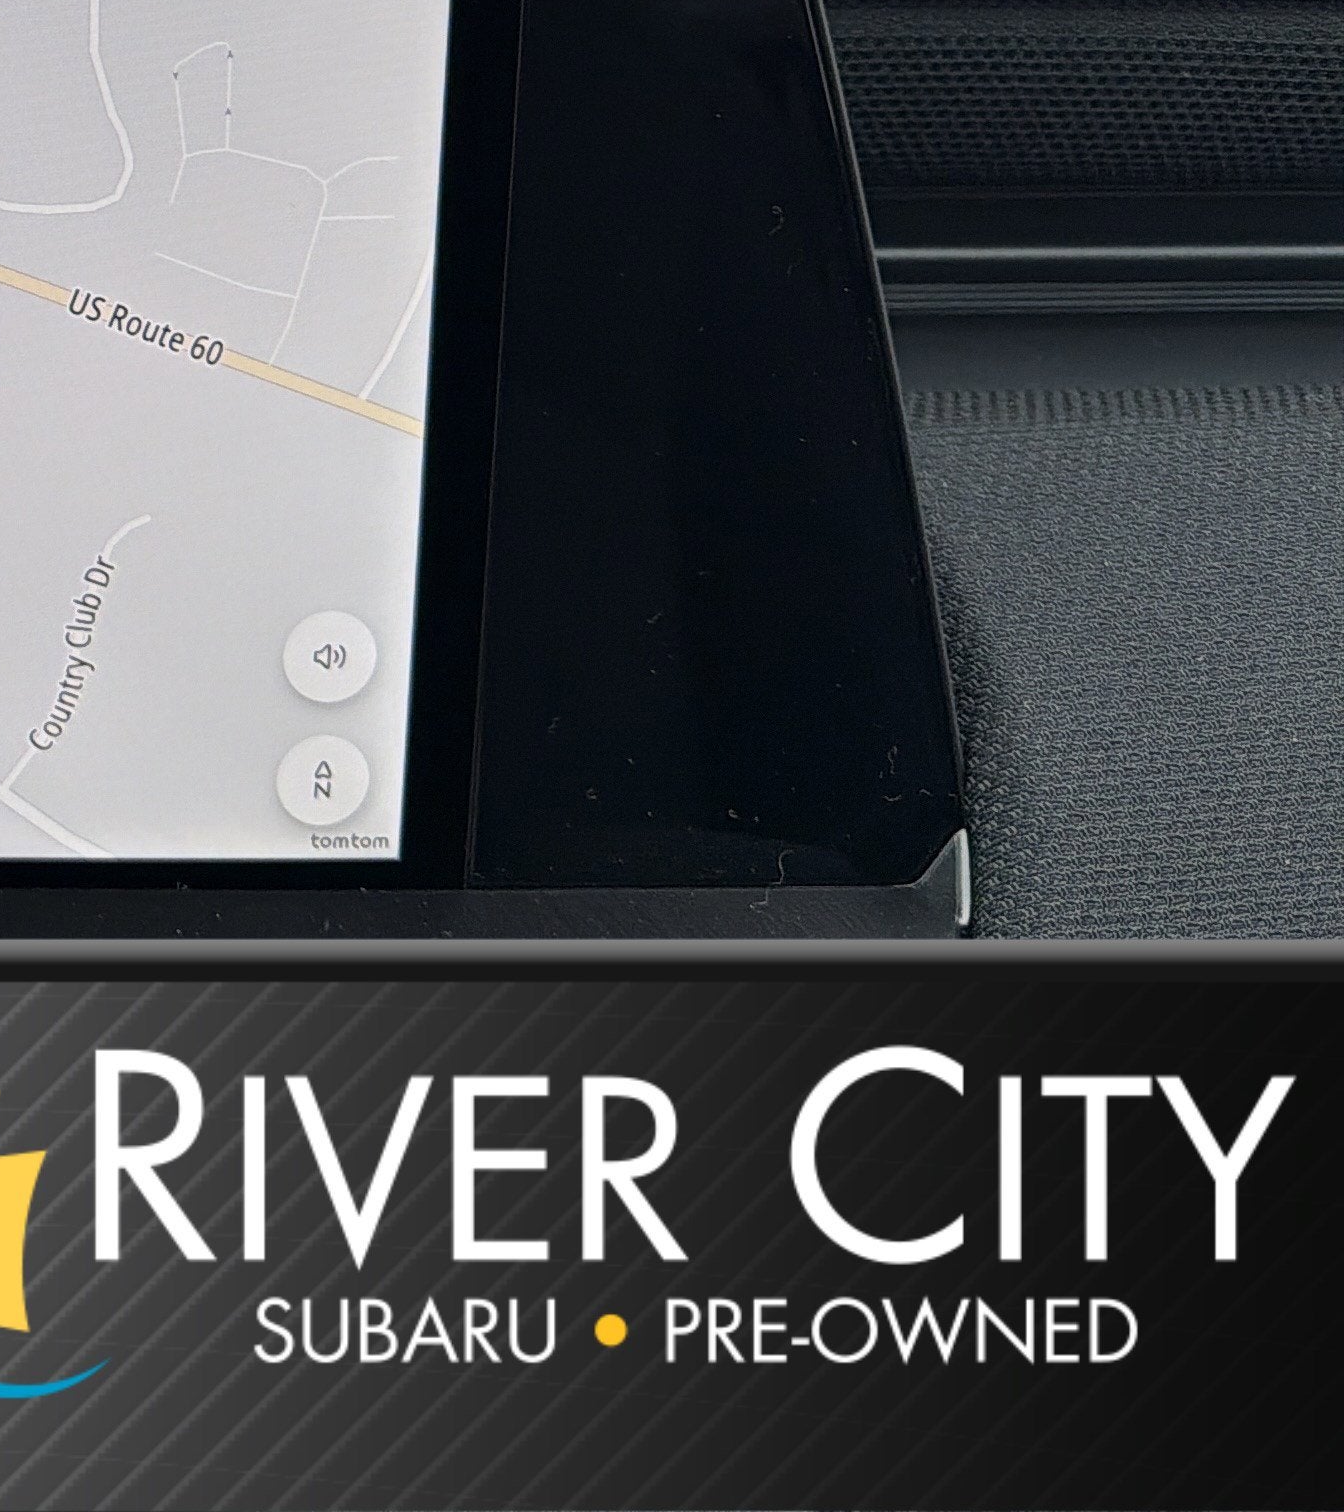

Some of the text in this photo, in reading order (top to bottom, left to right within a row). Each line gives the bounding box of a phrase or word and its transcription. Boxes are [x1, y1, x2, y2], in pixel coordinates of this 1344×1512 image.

[68, 288, 224, 365] US Route 60
[29, 555, 115, 751] Country Club Dr
[311, 833, 389, 849] tomtom
